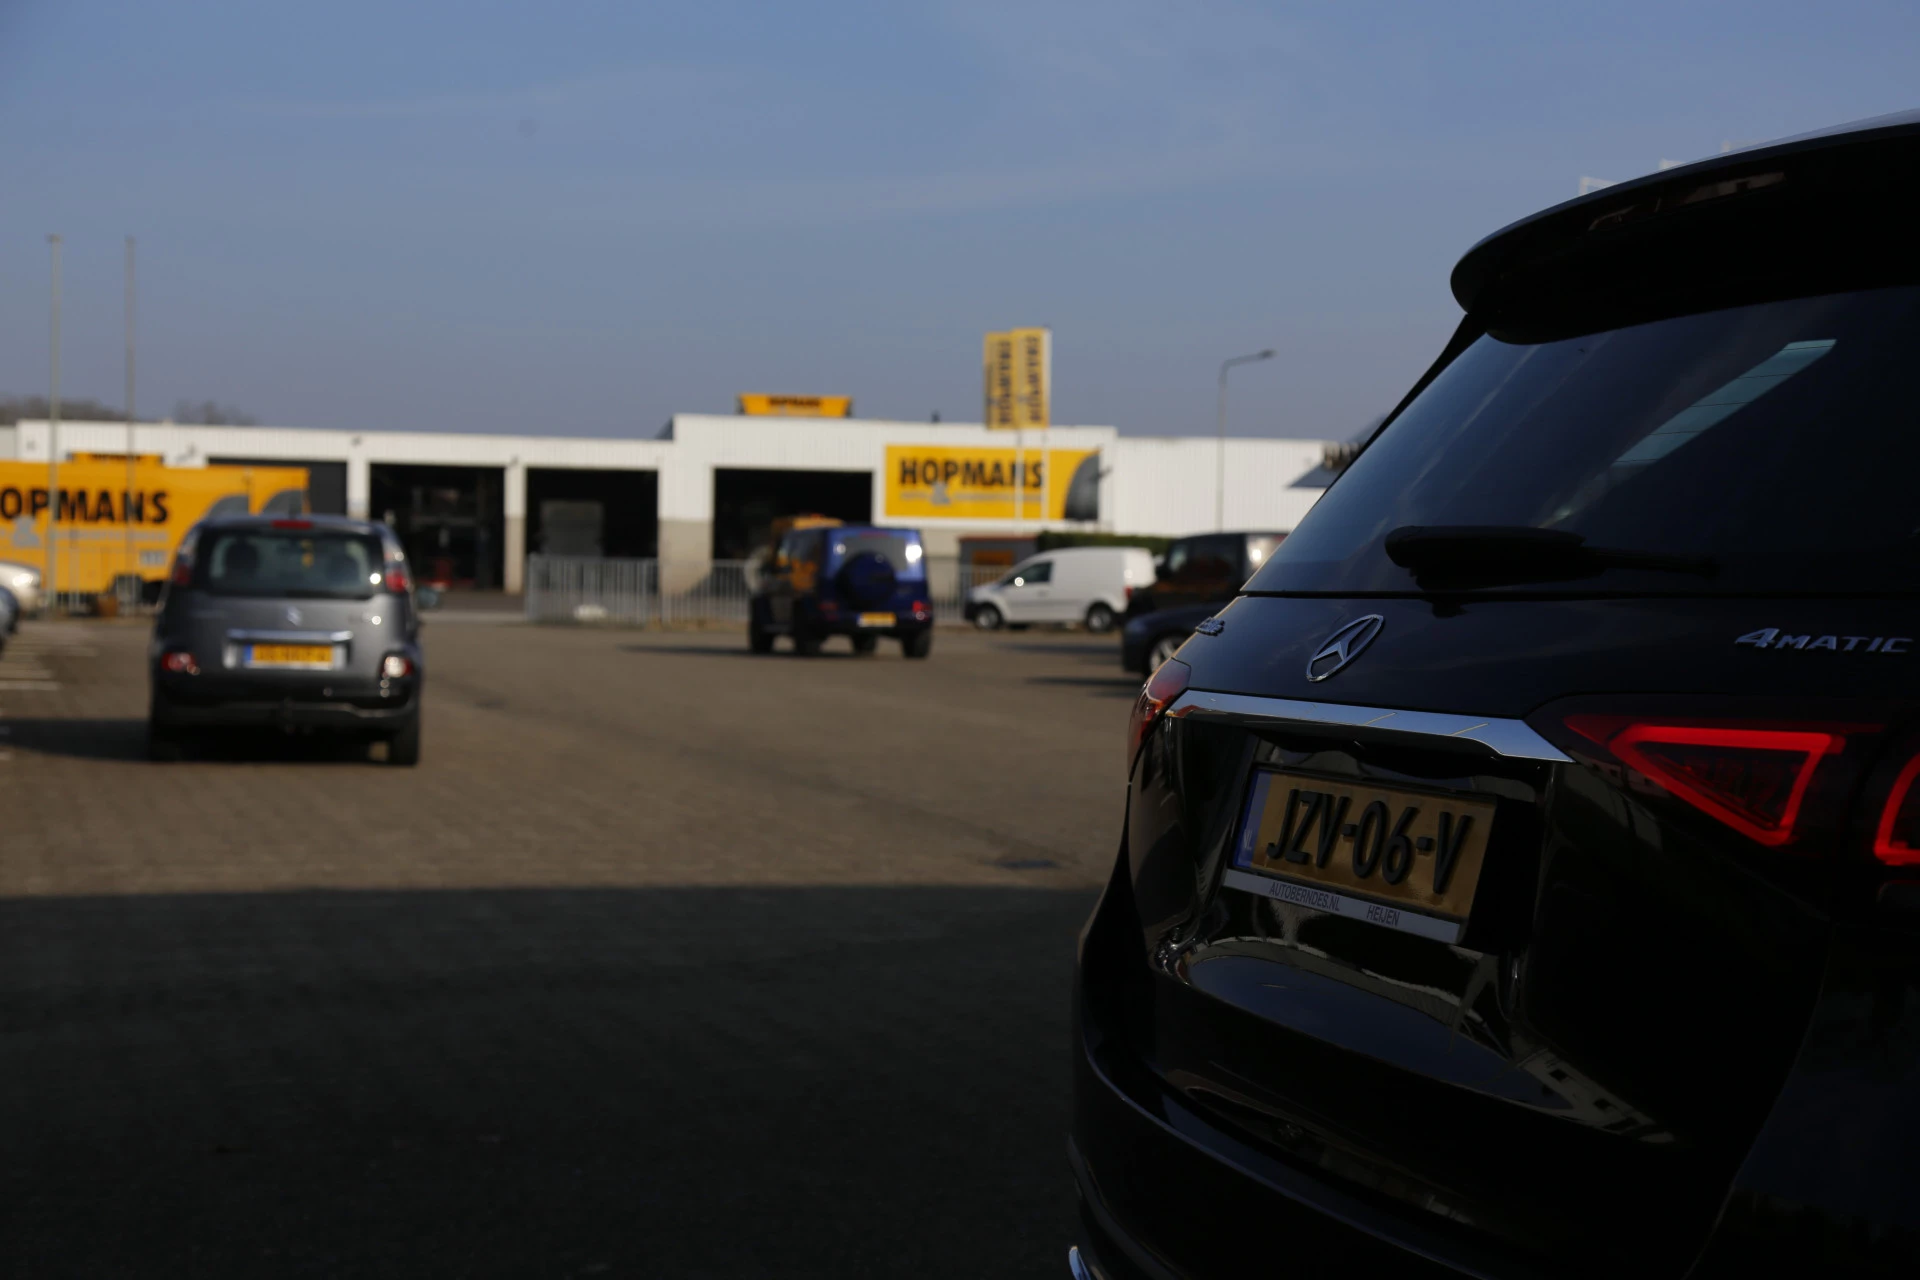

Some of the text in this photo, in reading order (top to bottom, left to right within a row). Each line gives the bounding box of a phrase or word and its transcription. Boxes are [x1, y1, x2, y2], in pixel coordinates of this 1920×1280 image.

[899, 457, 1045, 488] HOPMANS
[0, 487, 168, 523] OPMANS
[1733, 627, 1915, 653] 4MATIC
[1266, 787, 1475, 895] JZV-06-V
[1269, 881, 1401, 926] AUTOBERNDES.NL HEIJEN
